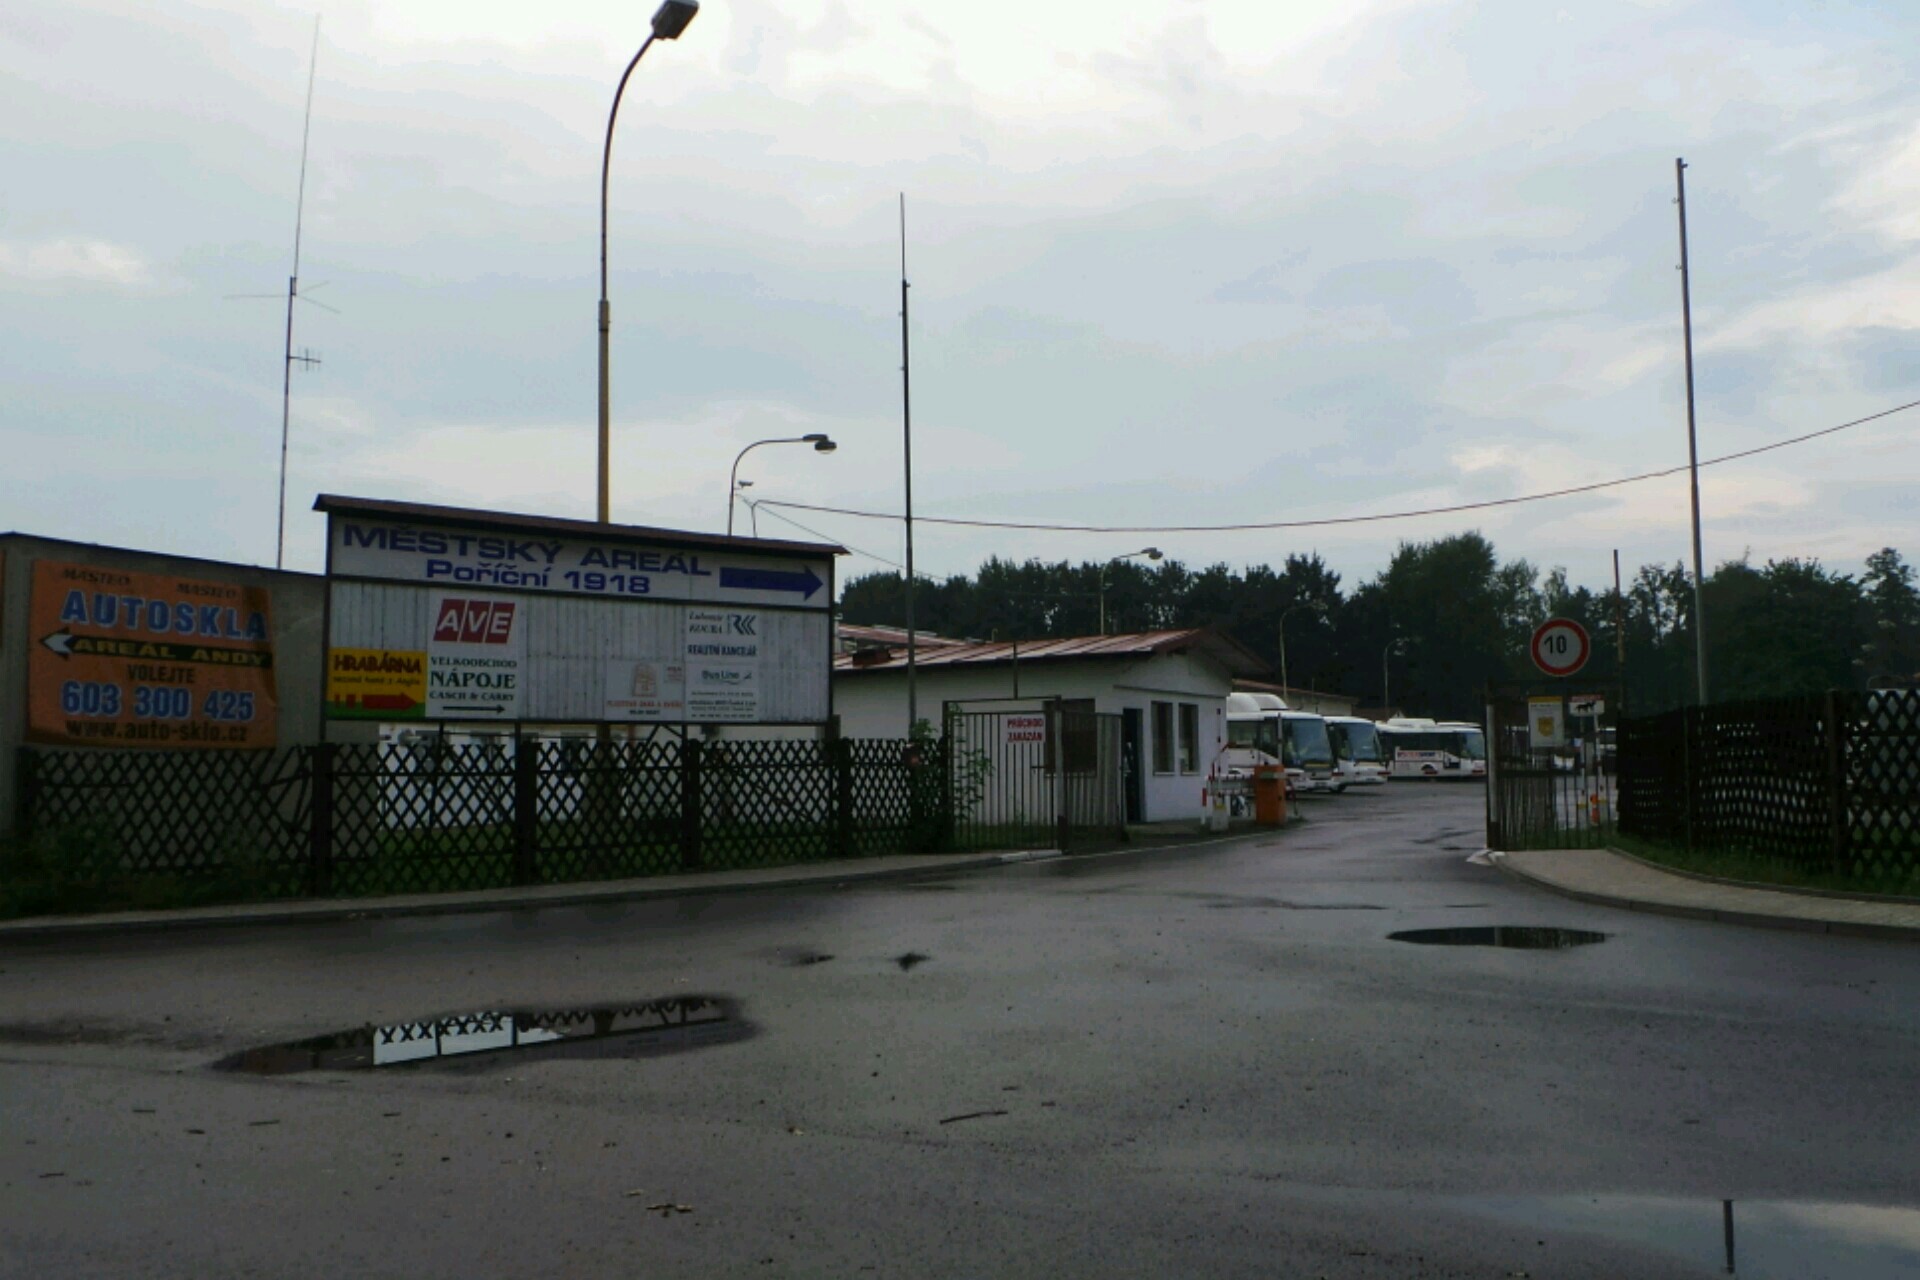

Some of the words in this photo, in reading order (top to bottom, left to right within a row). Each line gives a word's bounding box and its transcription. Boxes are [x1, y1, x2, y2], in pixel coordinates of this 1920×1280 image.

[344, 523, 563, 564] MĚSTSKÝ
[580, 546, 712, 576] AREÁL
[426, 559, 552, 587] Poříční
[564, 571, 651, 594] 1918
[60, 588, 268, 641] AUTOSKLA
[437, 609, 512, 635] AVE
[1544, 635, 1567, 654] 10
[191, 648, 267, 666] ANDY
[334, 652, 421, 673] HRABÁRNA
[430, 656, 517, 667] VELKOOBCHOD
[127, 664, 195, 683] VOLEJTE
[430, 667, 516, 689] NÁPOJE
[61, 681, 121, 716] 603
[134, 685, 191, 719] 300
[204, 690, 255, 721] 425
[481, 692, 514, 701] CARRY
[66, 720, 247, 742] www.auto-sklo.cz
